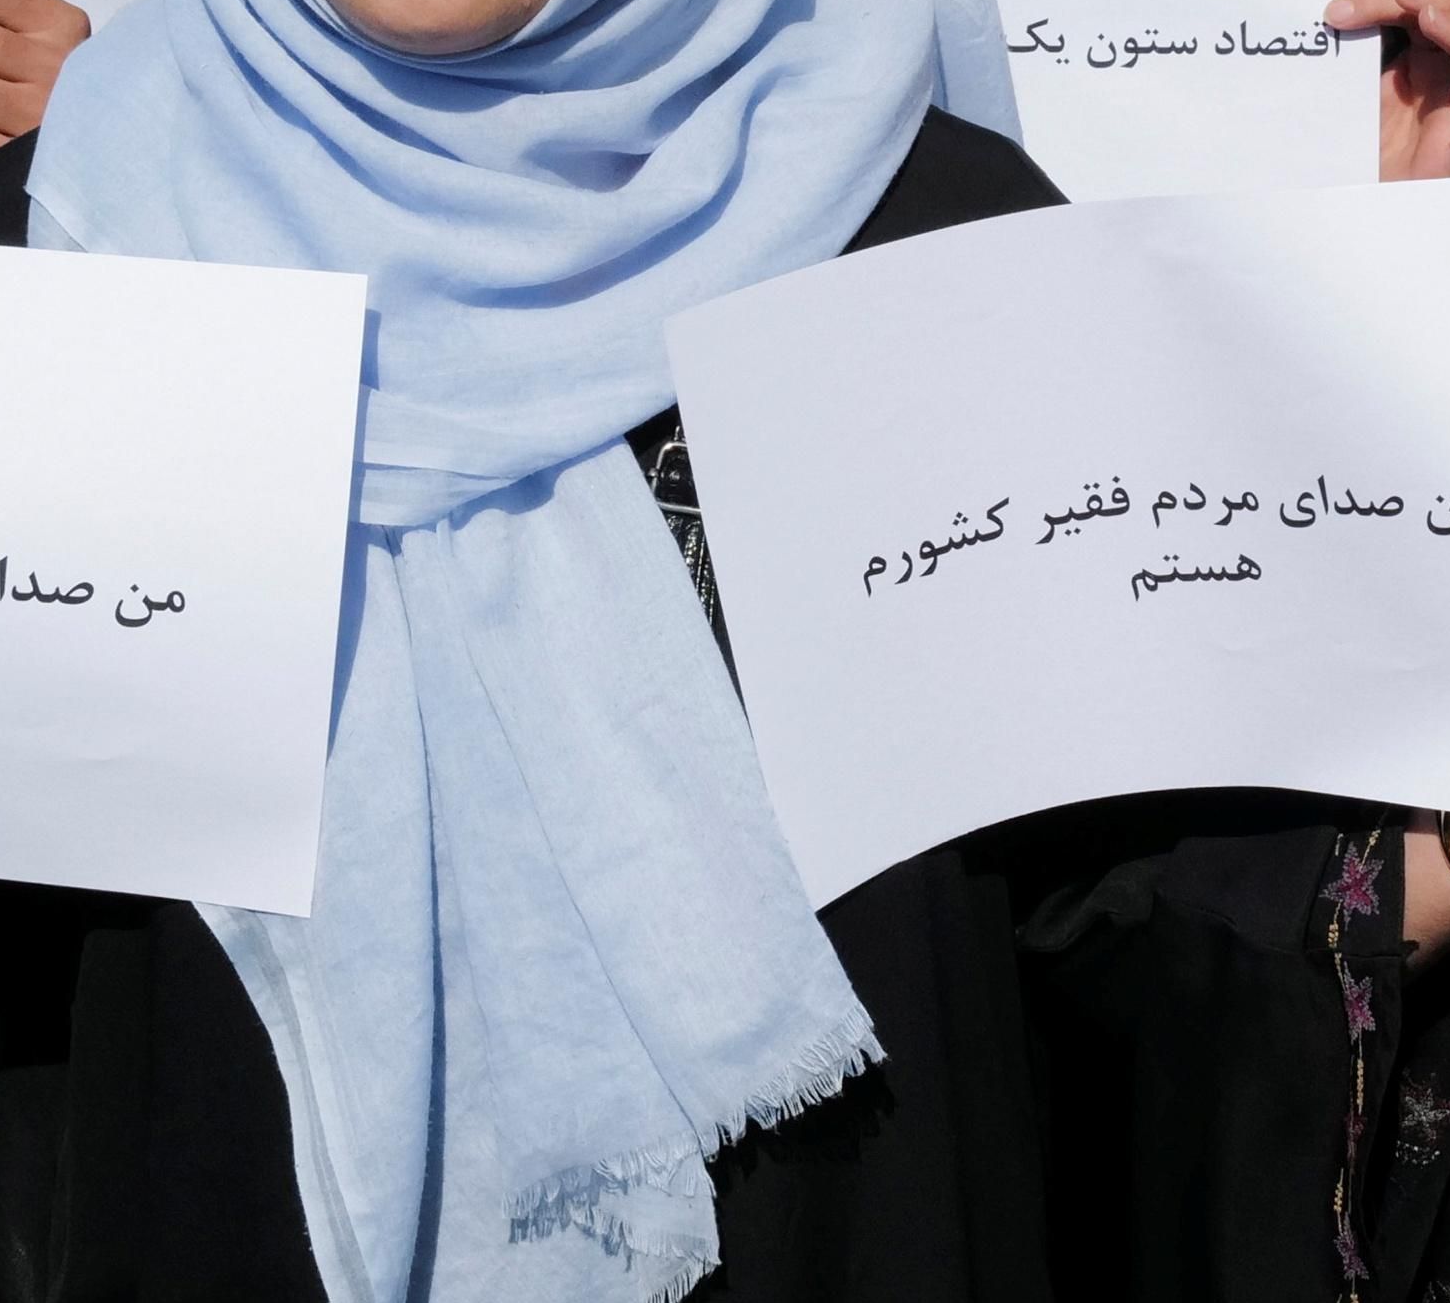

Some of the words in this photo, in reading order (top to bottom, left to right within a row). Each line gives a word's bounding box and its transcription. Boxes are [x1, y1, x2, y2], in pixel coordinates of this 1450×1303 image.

[1007, 18, 1070, 65] یک
[1086, 29, 1198, 69] ستون
[1214, 19, 1342, 57] اقتصاد
[1035, 475, 1131, 545] فقیر
[1151, 482, 1260, 529] مردم
[1279, 474, 1405, 529] صدای
[863, 496, 1010, 598] کشورم
[1131, 553, 1262, 602] هستم
[114, 583, 186, 628] من
